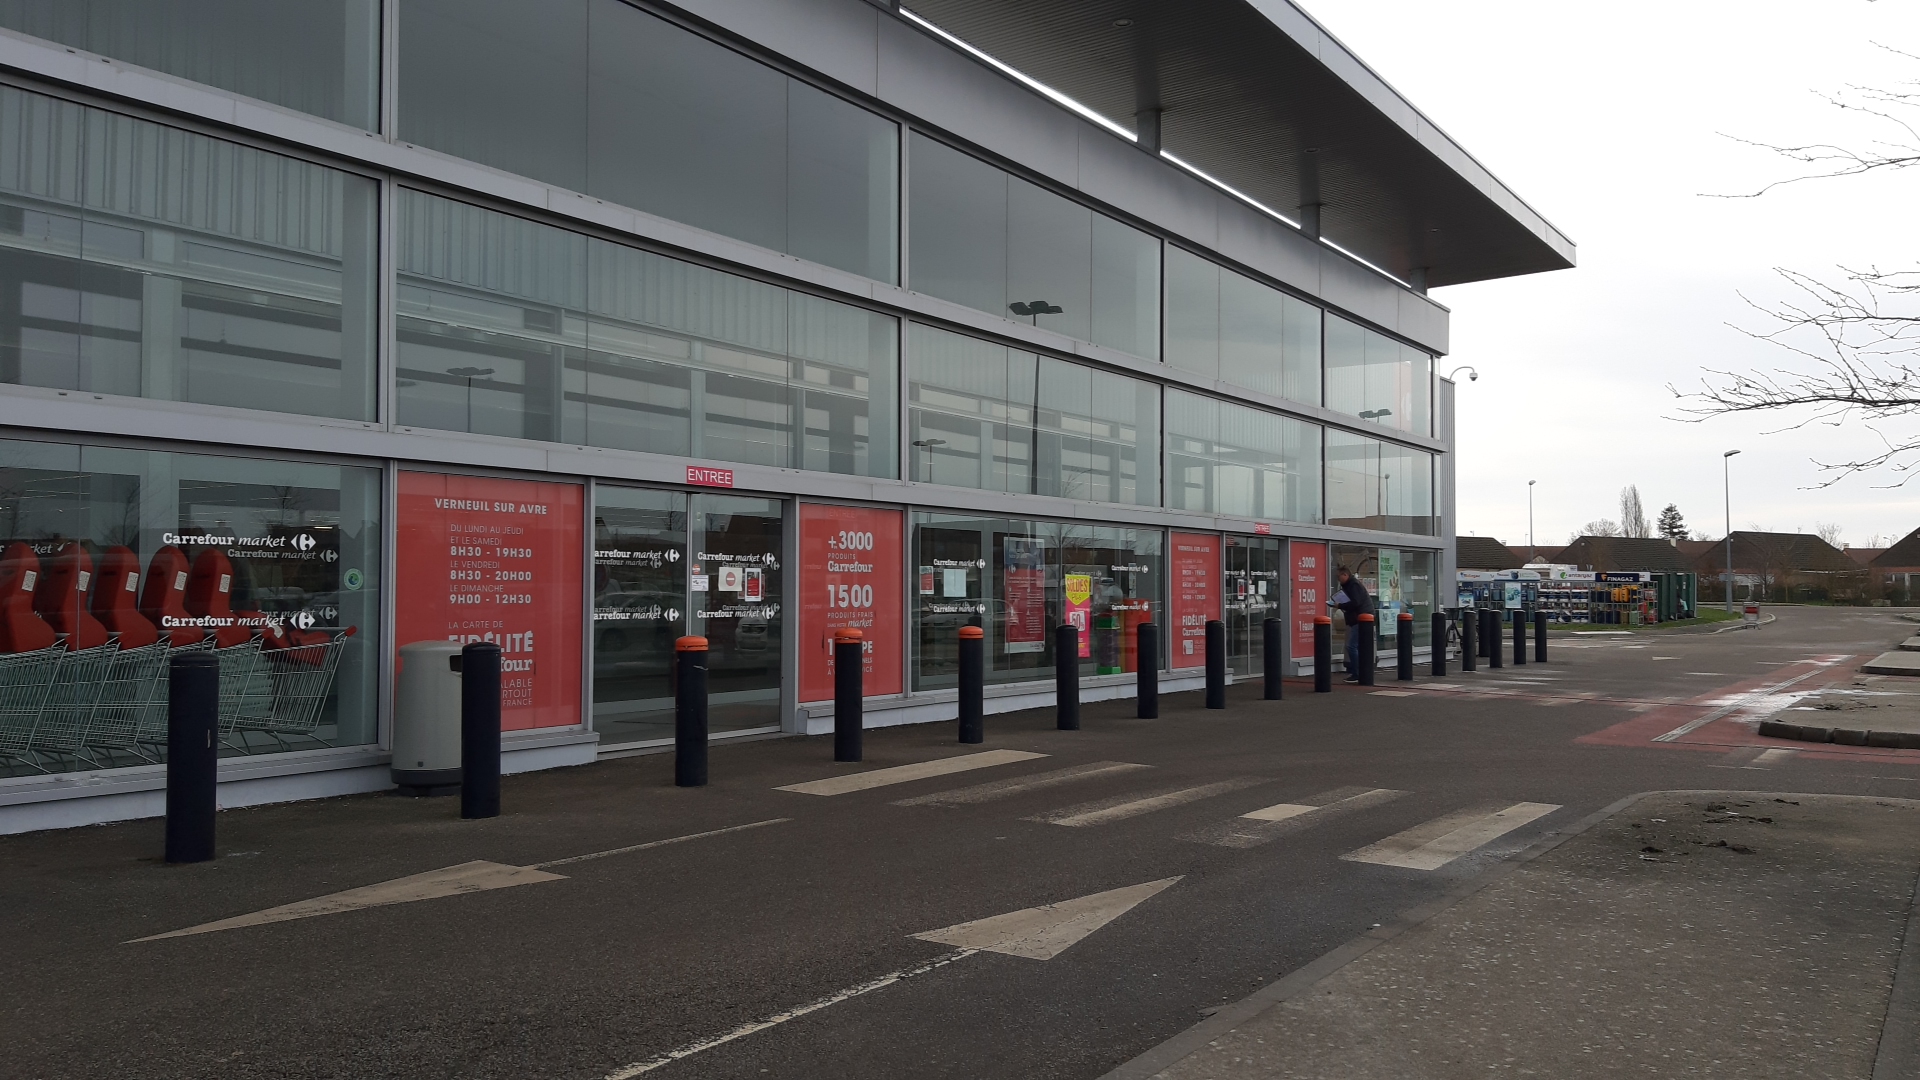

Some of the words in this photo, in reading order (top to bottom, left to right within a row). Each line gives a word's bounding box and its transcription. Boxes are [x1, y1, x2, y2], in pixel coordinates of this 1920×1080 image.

[688, 469, 732, 484] ENTREE
[434, 498, 490, 511] VERNEUIL
[494, 502, 515, 512] SUR
[519, 504, 547, 514] AVRE
[450, 524, 461, 532] DU
[464, 525, 487, 533] LUNDI
[489, 526, 500, 534] AU
[502, 526, 524, 535] JEUDI
[163, 533, 235, 545] Carrefour
[238, 535, 286, 547] market
[450, 536, 459, 544] ET
[472, 537, 502, 545] SAMEDI
[228, 549, 279, 558] Carrefour
[281, 551, 317, 560] market
[450, 546, 481, 557] 8H30
[496, 548, 532, 557] 19H30
[594, 549, 631, 558] arrefour
[633, 550, 662, 559] market
[697, 552, 734, 560] Carrefour
[735, 553, 760, 562] market
[450, 560, 458, 568] LE
[461, 560, 500, 569] VENDREDI
[827, 561, 873, 572] Carrefour
[450, 570, 481, 580] 8H30
[495, 571, 532, 581] 20H00
[1067, 578, 1088, 592] SOLDES
[450, 594, 481, 604] 9H00
[495, 594, 532, 604] 12H30
[828, 584, 873, 608] 1500
[1299, 589, 1316, 602] 1500
[593, 611, 631, 620] arrefour
[632, 612, 661, 620] market
[697, 610, 733, 618] Carrefour
[735, 610, 760, 618] market
[162, 615, 234, 627] Carrefour
[237, 615, 285, 627] market
[448, 621, 459, 629] LA
[462, 620, 489, 629] CARTE
[493, 620, 504, 628] DE
[847, 618, 873, 628] market
[1182, 627, 1206, 636] Carrefou
[501, 678, 533, 689] LABLE
[503, 689, 532, 698] RTOUT
[503, 698, 533, 707] FRANCE
